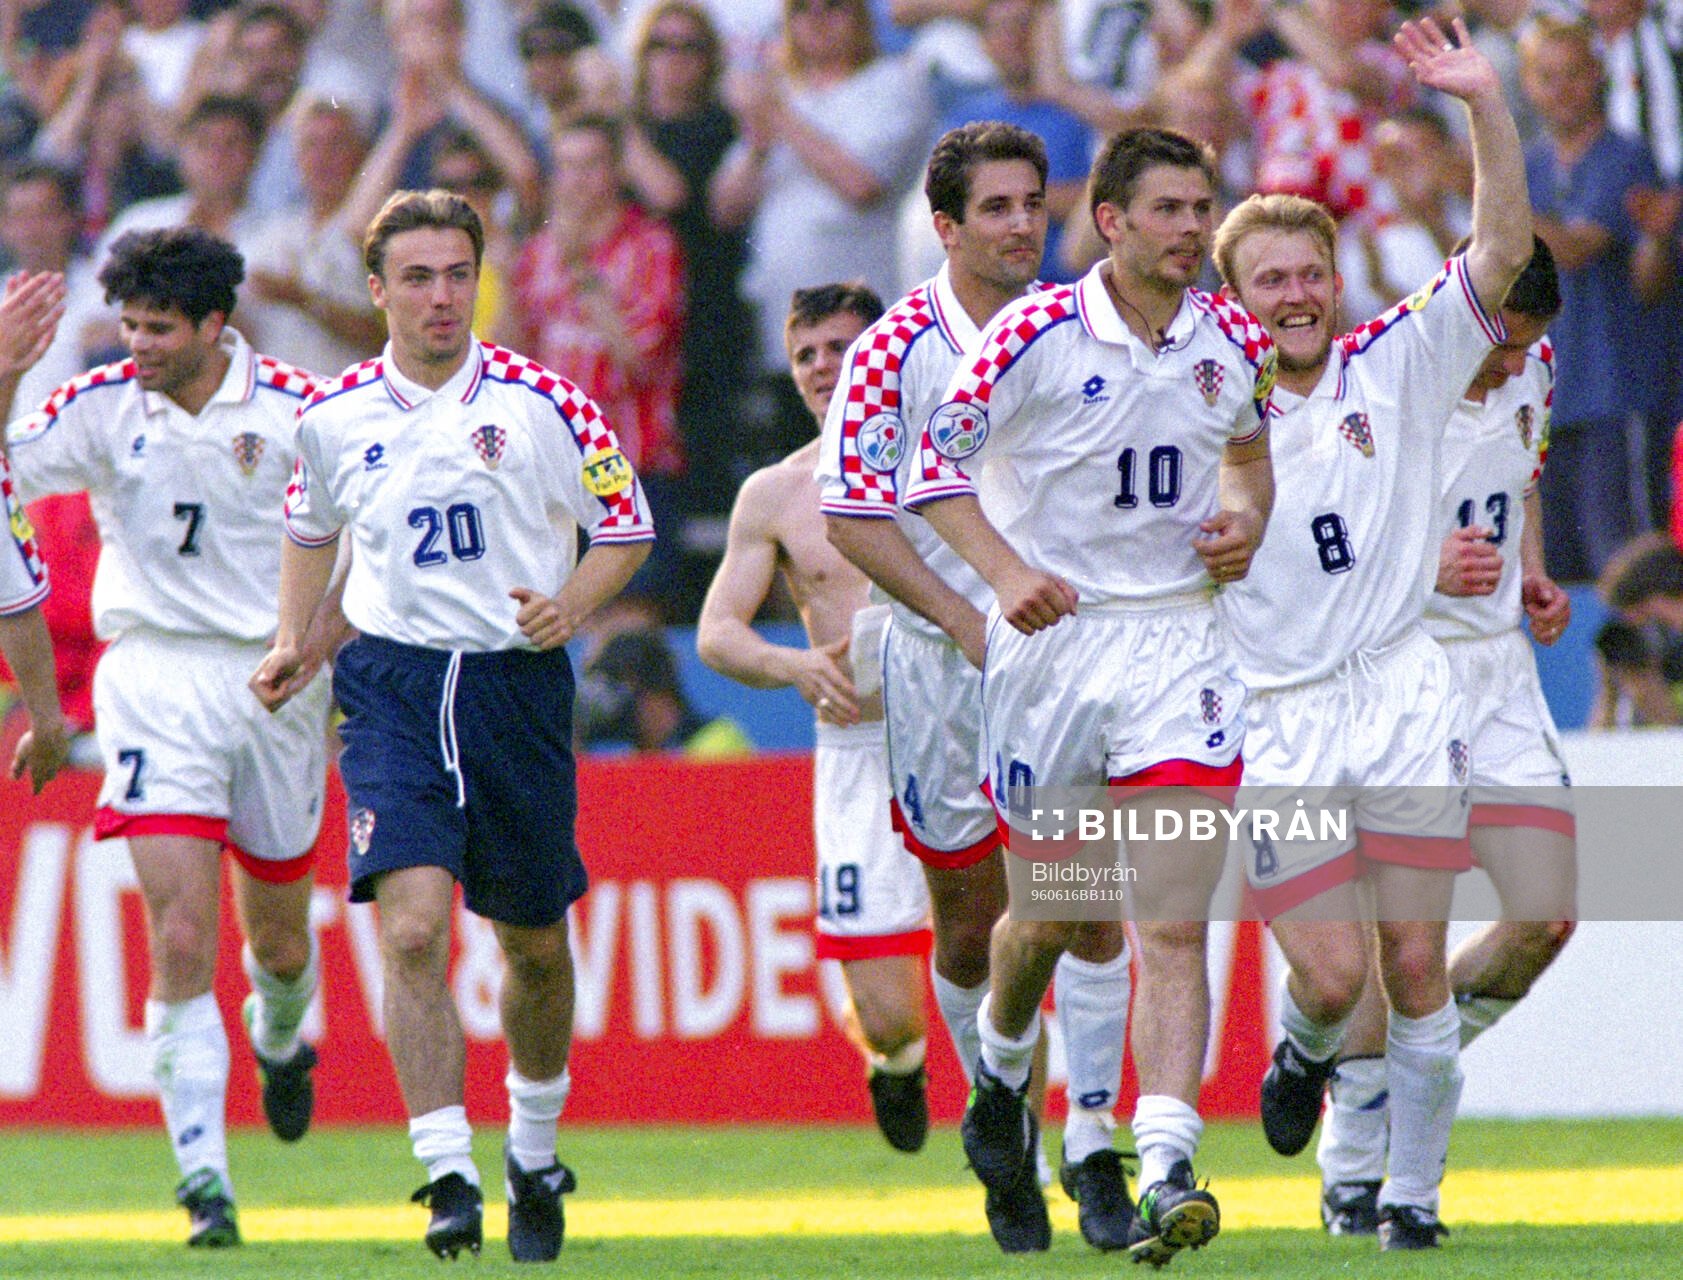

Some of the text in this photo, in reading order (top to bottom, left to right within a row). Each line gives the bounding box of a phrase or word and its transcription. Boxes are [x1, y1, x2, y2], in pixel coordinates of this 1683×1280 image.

[1114, 445, 1183, 509] 10
[174, 501, 206, 556] 7
[408, 502, 485, 568] 20
[1311, 512, 1356, 575] 8
[1457, 491, 1511, 548] 13
[118, 748, 146, 801] 7
[904, 773, 926, 830] 4
[820, 863, 862, 920] 19
